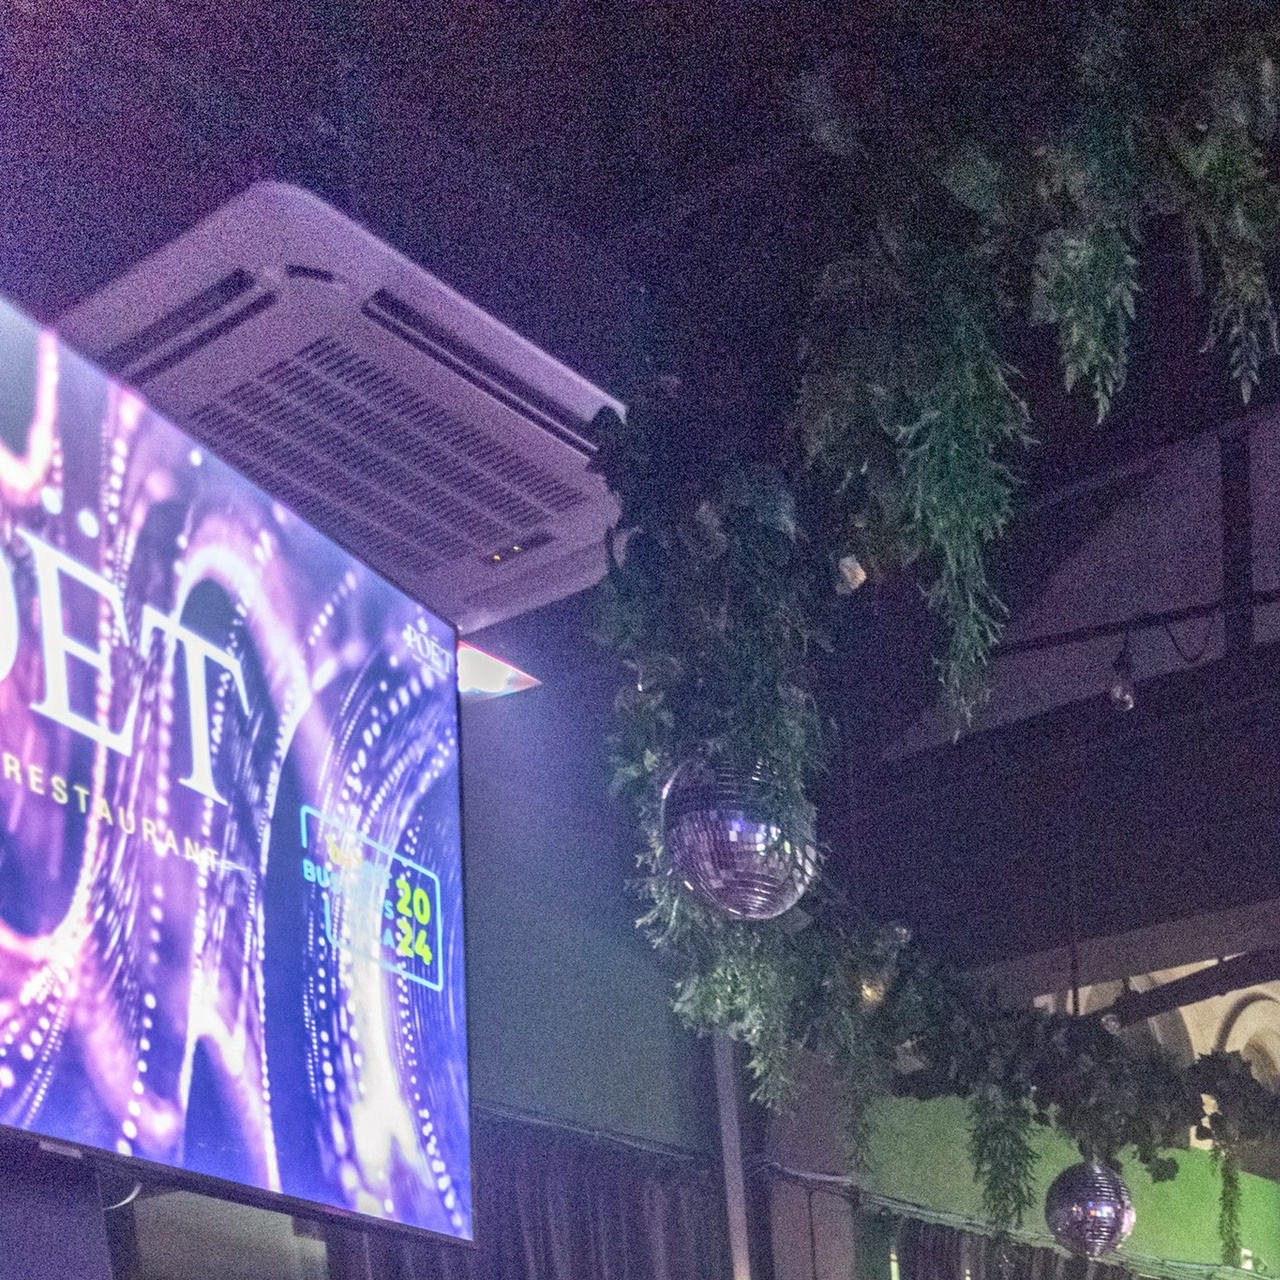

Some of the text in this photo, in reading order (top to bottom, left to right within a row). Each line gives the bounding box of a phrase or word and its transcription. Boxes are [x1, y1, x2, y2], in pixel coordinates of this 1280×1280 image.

[0, 526, 250, 806] ET
[3, 753, 219, 872] RESTAURANT
[396, 878, 431, 925] 20
[397, 920, 433, 966] 24
